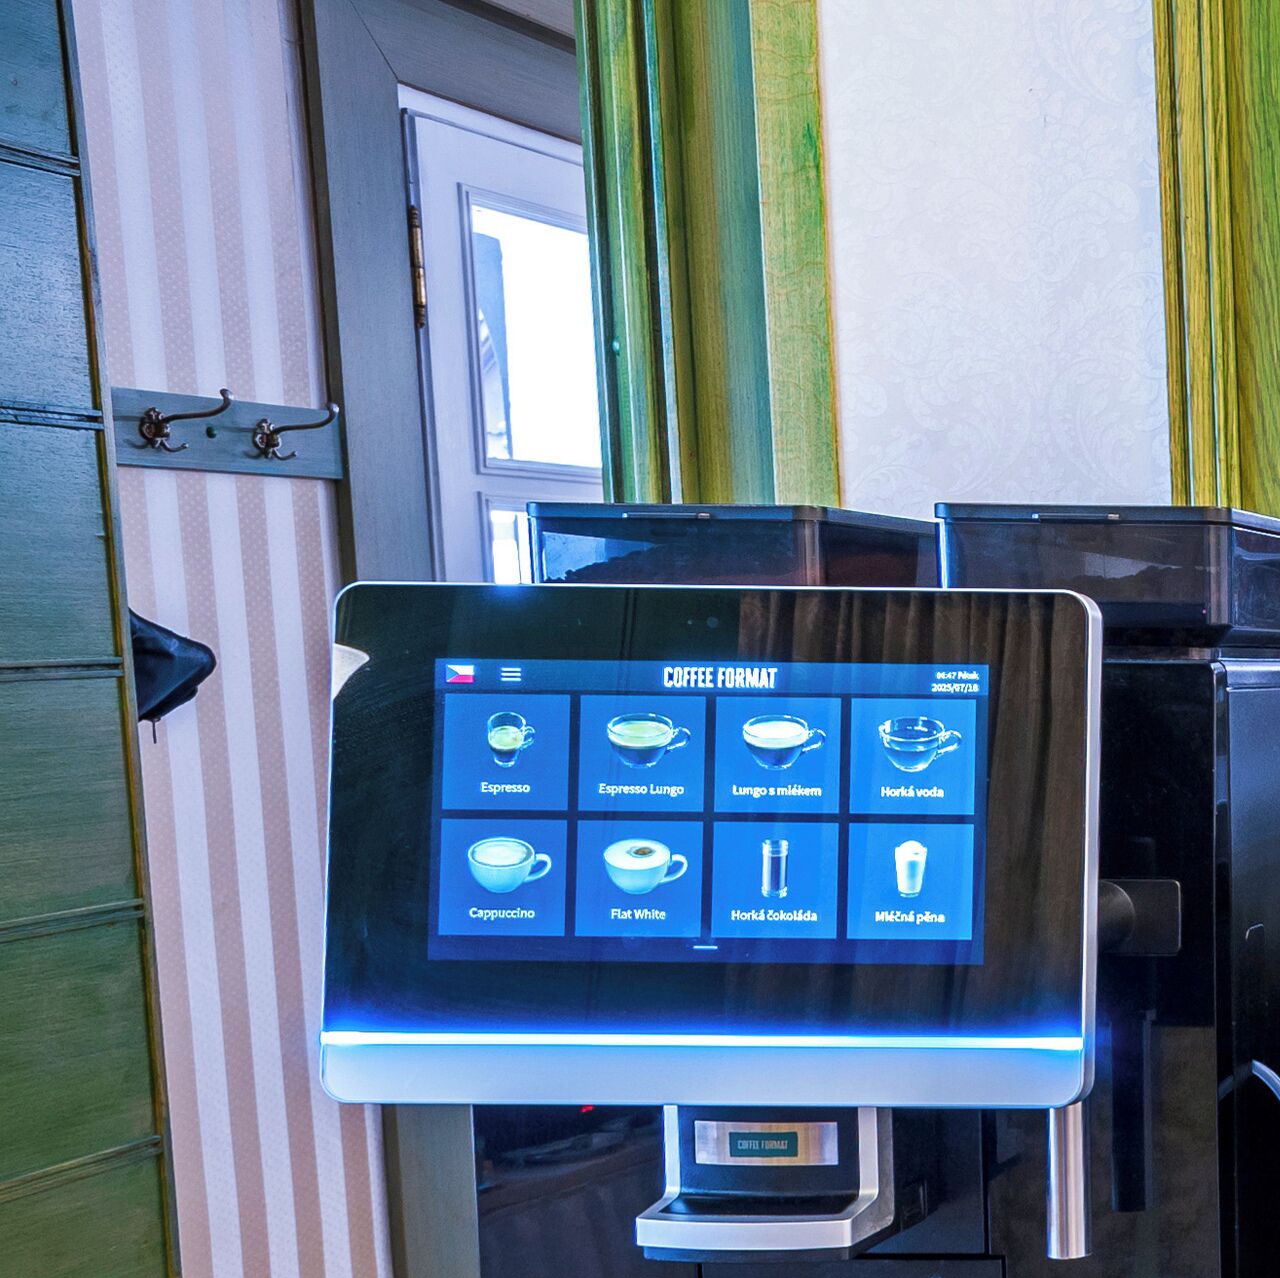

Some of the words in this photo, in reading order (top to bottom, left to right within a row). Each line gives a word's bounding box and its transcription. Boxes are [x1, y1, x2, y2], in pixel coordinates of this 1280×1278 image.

[663, 666, 714, 688] COFFEE
[717, 667, 778, 689] FORMAT
[480, 782, 531, 795] Espresso
[598, 783, 648, 795] Espresso
[649, 784, 685, 797] Lungo
[732, 784, 767, 798] Lungo
[768, 787, 776, 796] s
[776, 784, 822, 796] mlékem
[880, 785, 915, 798] Horká
[915, 786, 945, 798] voda
[469, 907, 535, 920] Cappuccino
[610, 908, 633, 920] Flat
[634, 909, 667, 920] White
[731, 909, 765, 921] Horká
[766, 909, 817, 921] čokoláda
[875, 910, 914, 923] Mléčná
[915, 911, 946, 925] pěna
